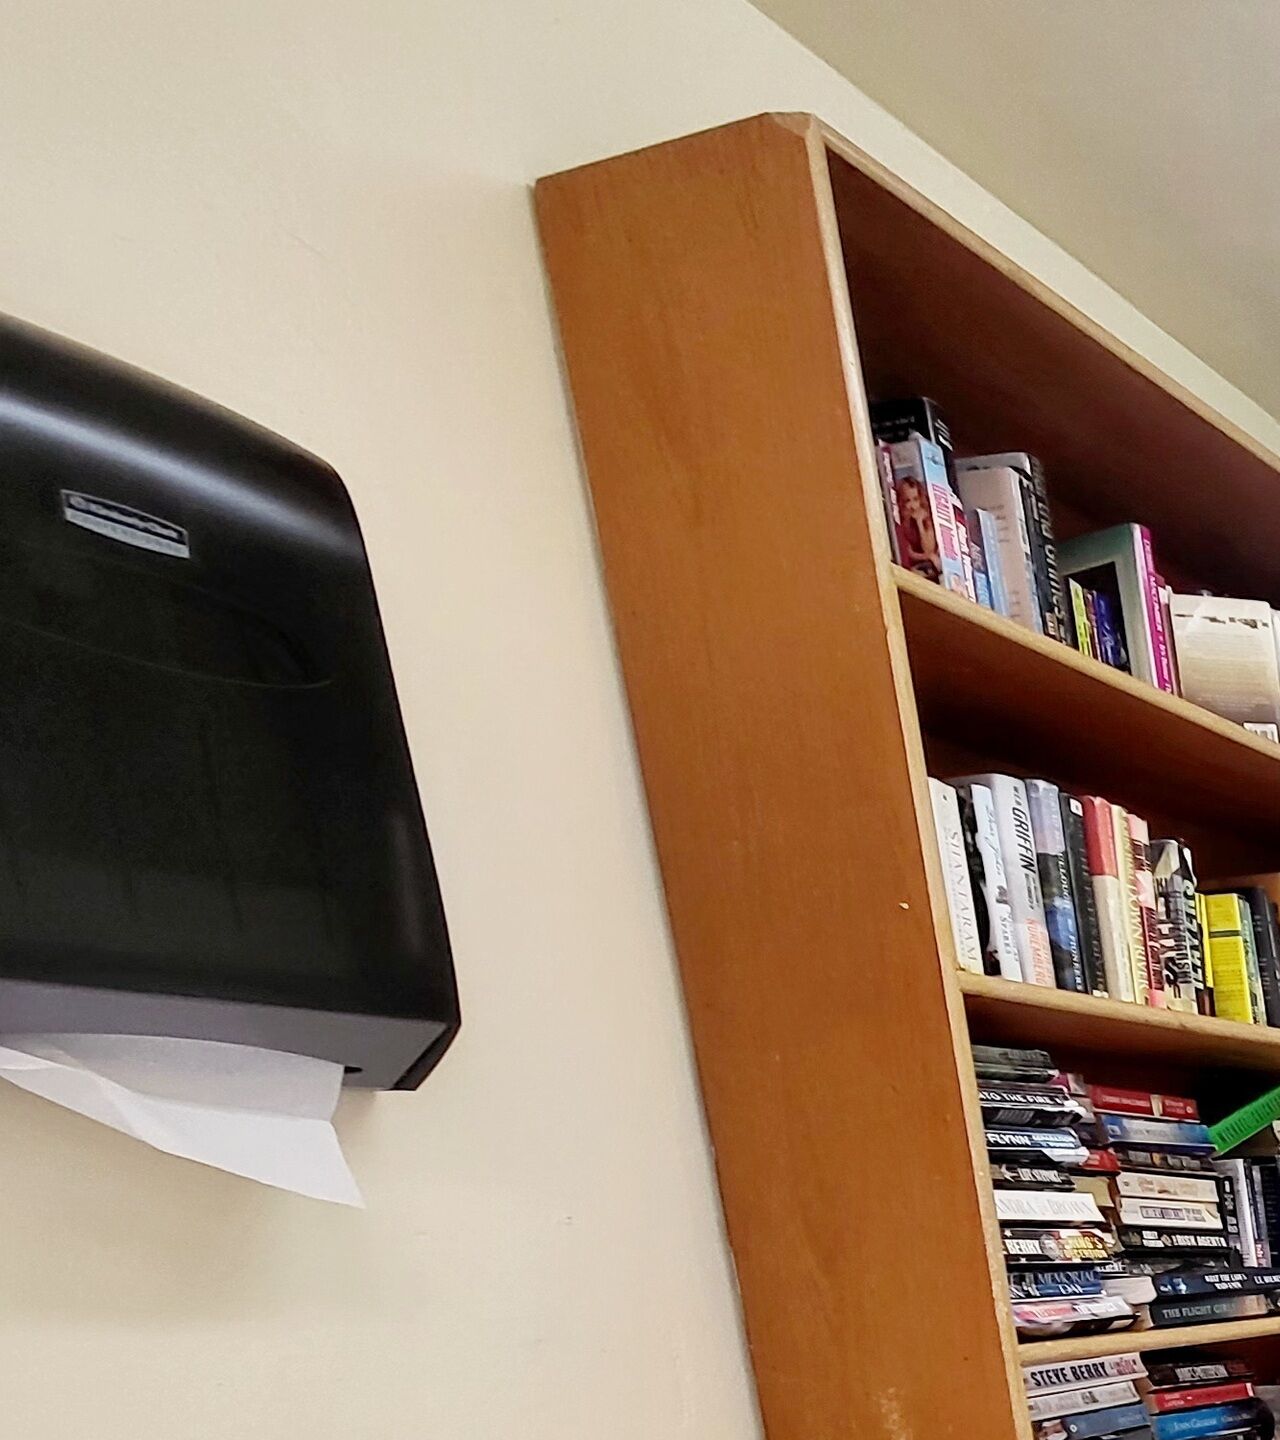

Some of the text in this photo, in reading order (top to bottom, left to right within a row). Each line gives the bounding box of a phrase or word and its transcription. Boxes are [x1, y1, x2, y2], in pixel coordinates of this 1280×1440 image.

[1012, 807, 1036, 874] GRIFFIN
[950, 831, 978, 961] SHANTARAM
[1128, 884, 1149, 991] DOWN RIVER
[1003, 1093, 1027, 1103] THE
[987, 1133, 1031, 1147] FLYNN
[1004, 1239, 1043, 1254] BERRY
[1037, 1271, 1097, 1284] MEMORIAL
[1162, 1307, 1181, 1319] THE
[1182, 1304, 1212, 1317] FLIGHT
[1030, 1366, 1070, 1387] STEVE
[1069, 1361, 1108, 1381] BERRY
